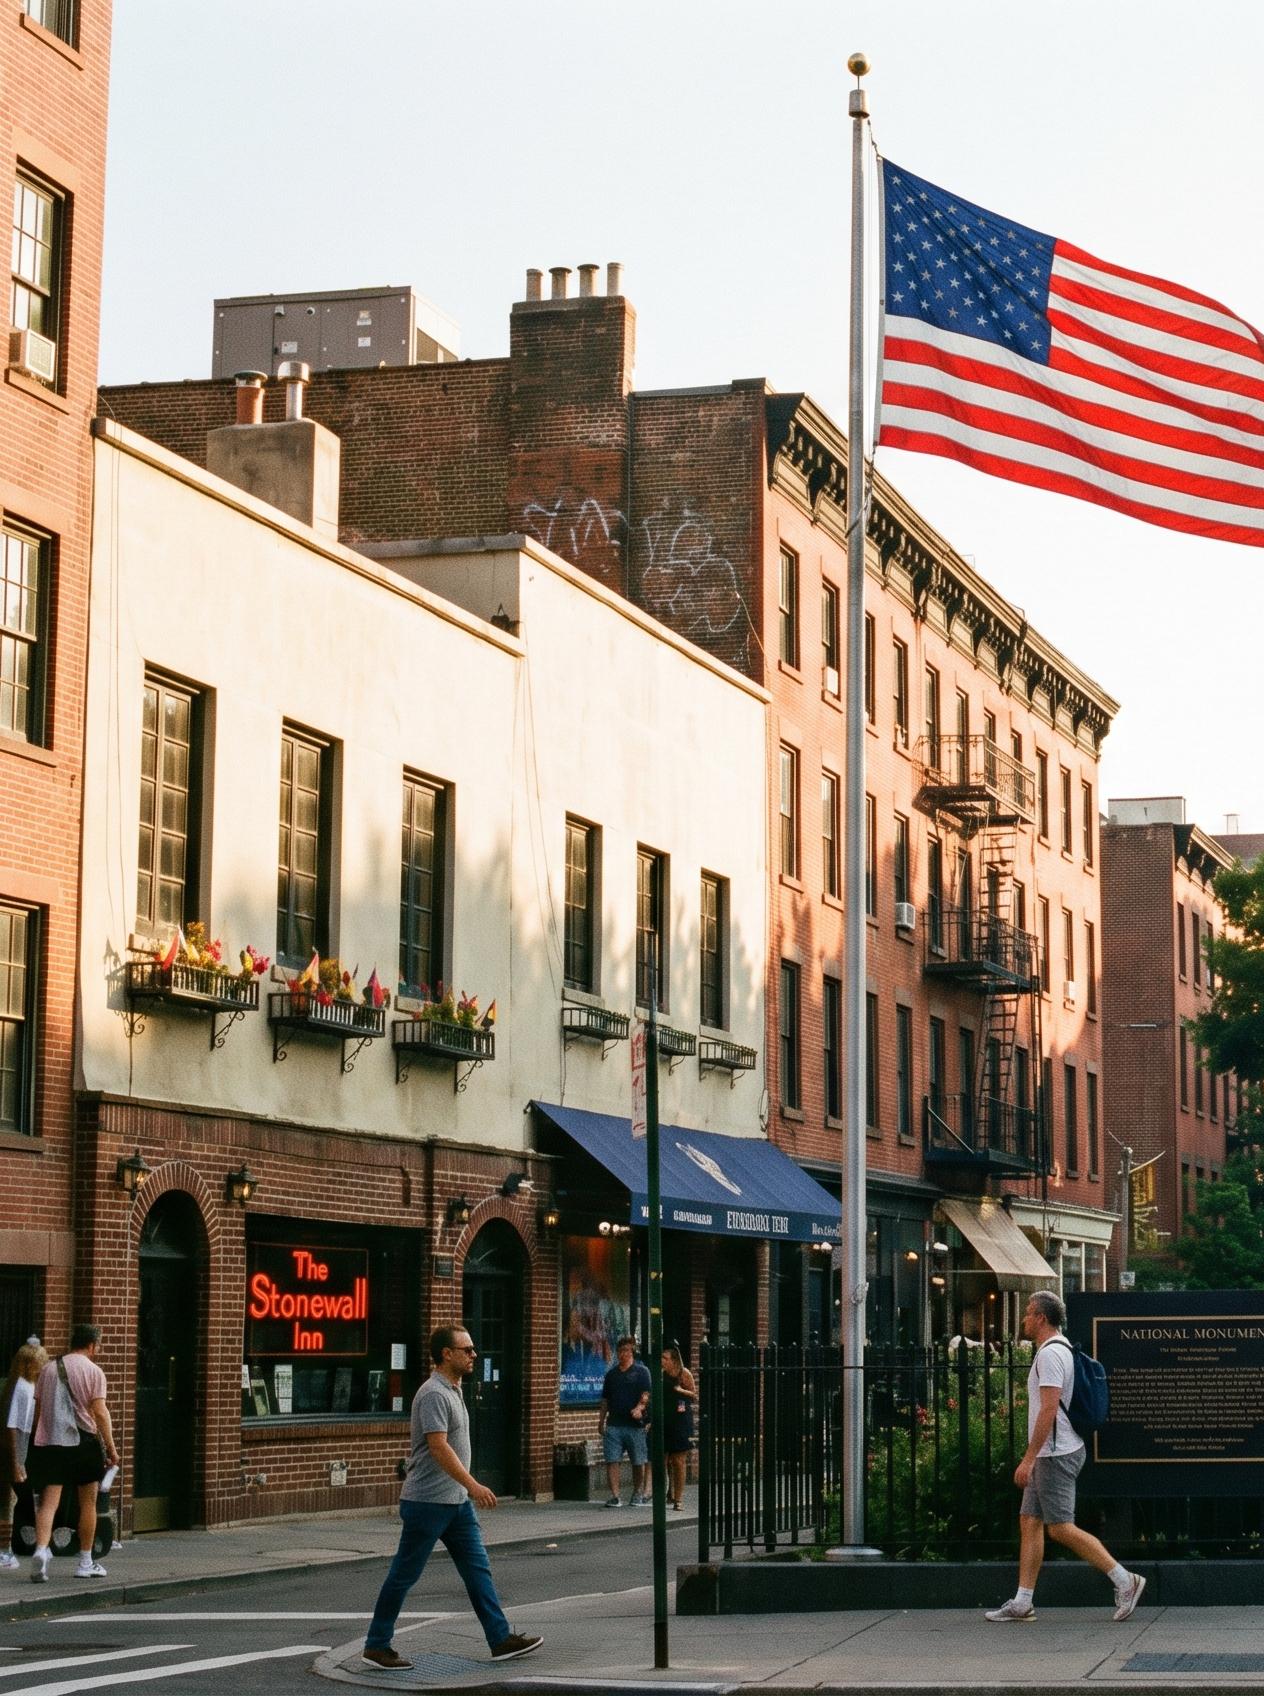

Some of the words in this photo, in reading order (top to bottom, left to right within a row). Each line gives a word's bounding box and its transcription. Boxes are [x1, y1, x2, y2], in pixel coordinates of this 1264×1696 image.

[292, 1250, 329, 1281] The
[250, 1273, 367, 1319] Stonewall
[293, 1321, 324, 1350] Inn
[1120, 1328, 1190, 1340] NATIONAL
